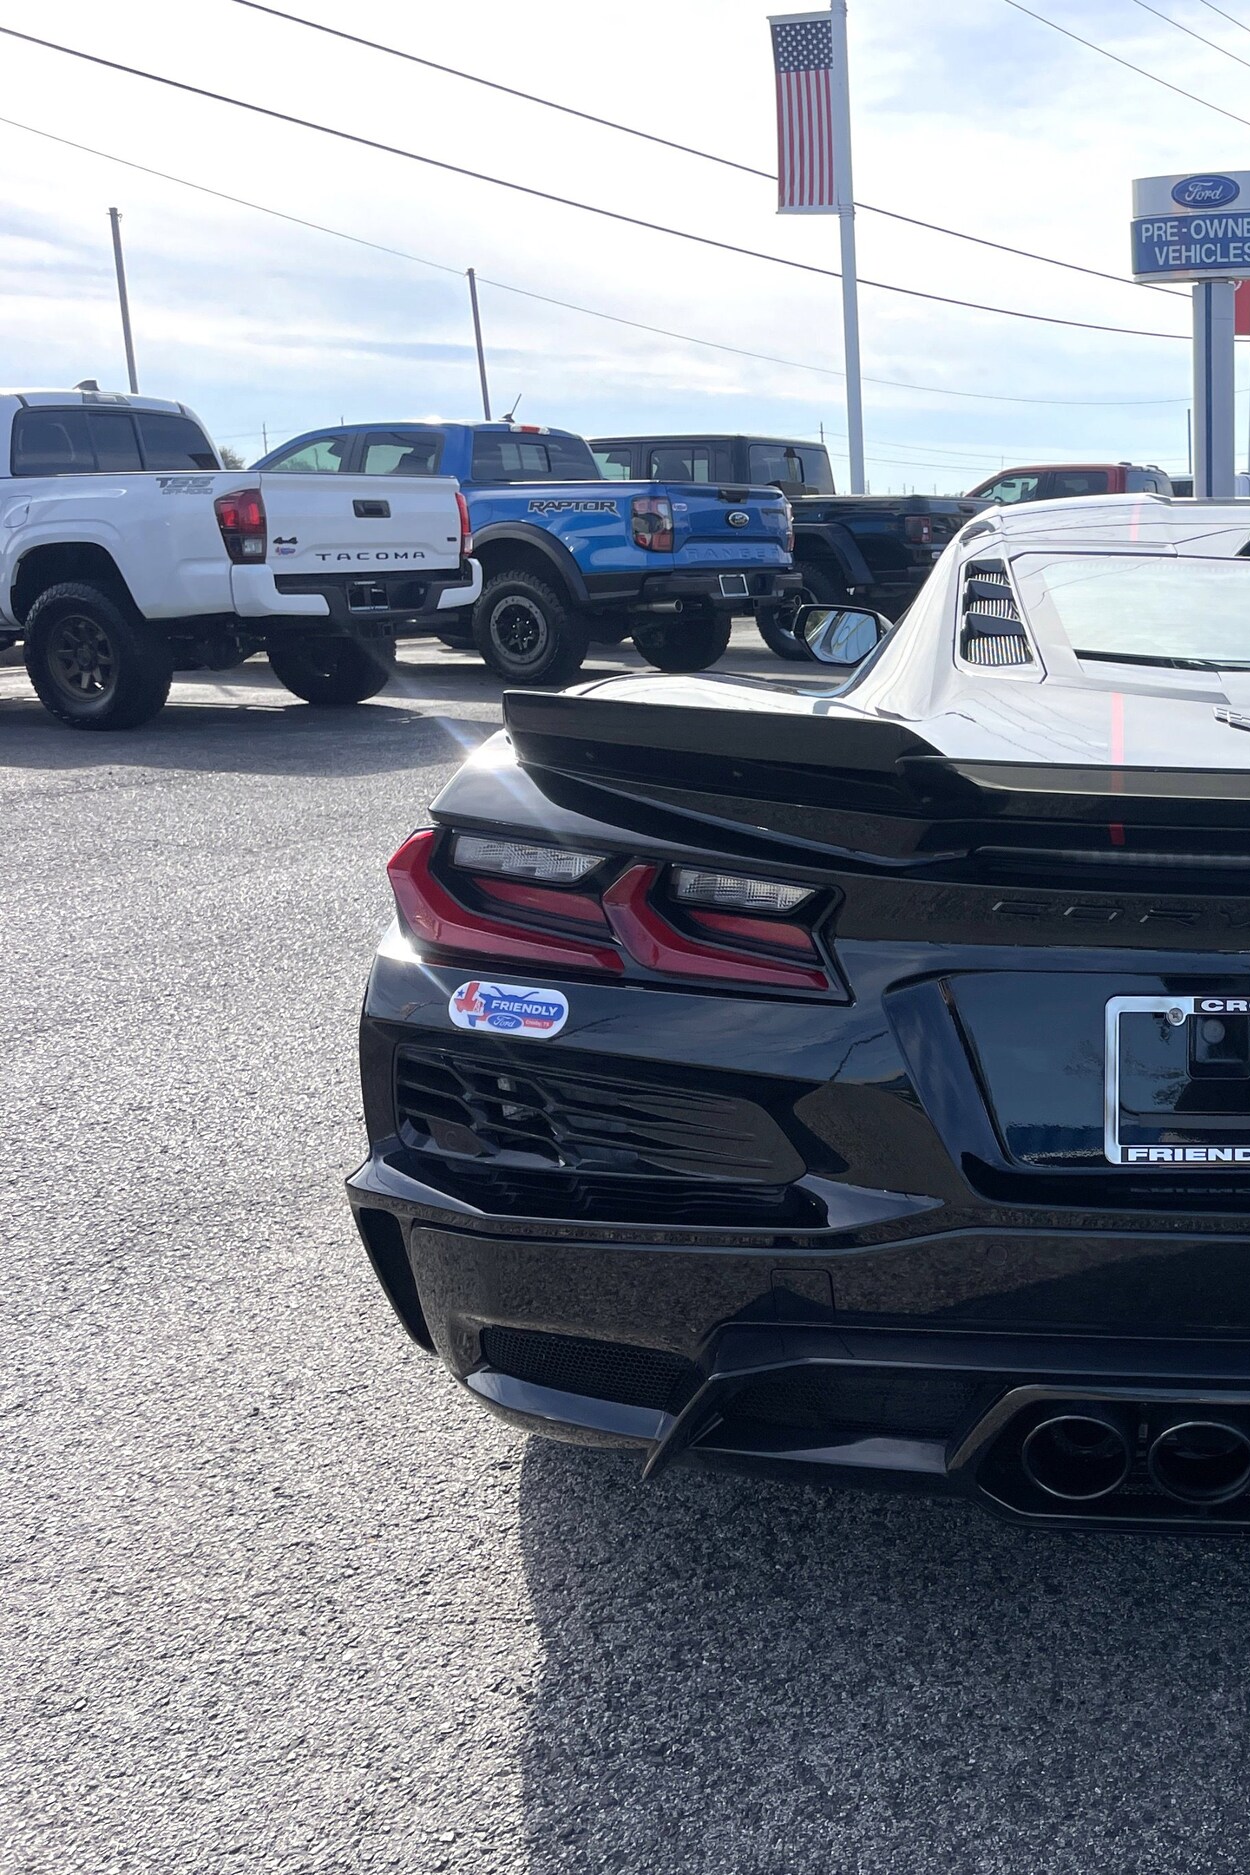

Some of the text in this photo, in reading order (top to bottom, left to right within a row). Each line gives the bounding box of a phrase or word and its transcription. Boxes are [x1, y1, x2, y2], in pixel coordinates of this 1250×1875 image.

[1185, 182, 1224, 201] Ford
[527, 500, 621, 518] RAPTOR
[315, 551, 425, 561] TACOMA
[491, 1000, 558, 1016] FRIENDLY
[493, 1016, 516, 1028] Ford
